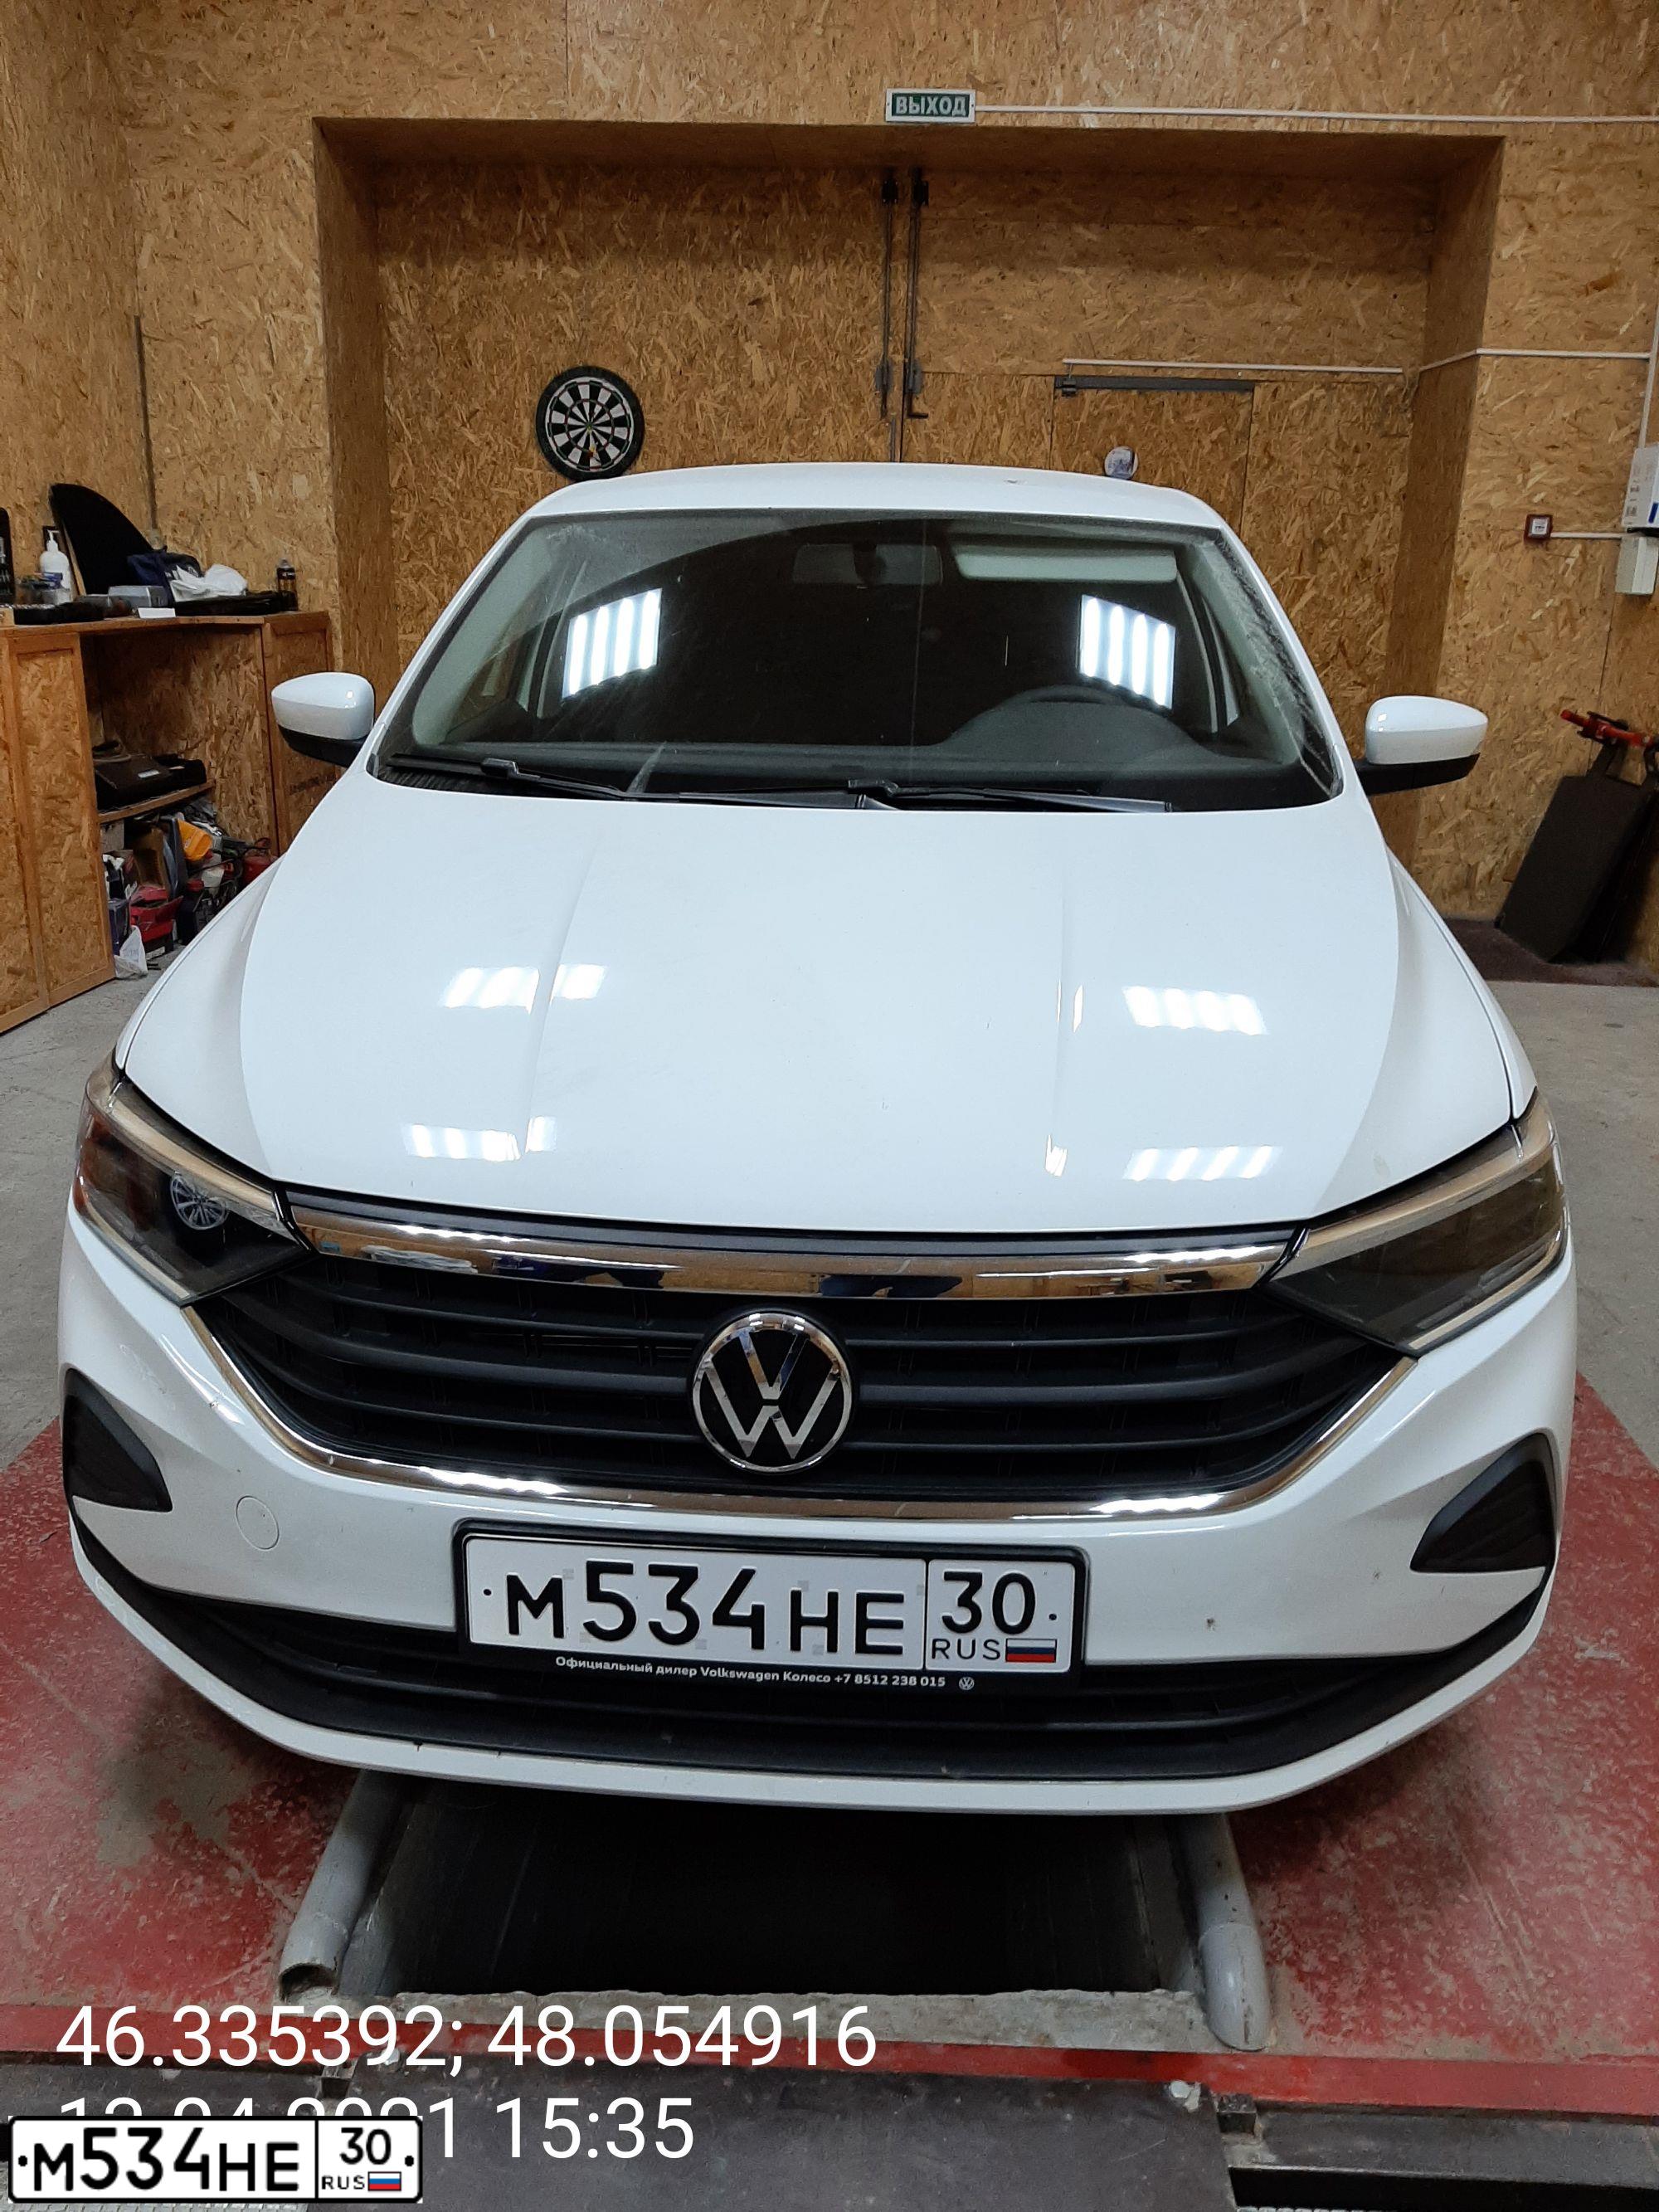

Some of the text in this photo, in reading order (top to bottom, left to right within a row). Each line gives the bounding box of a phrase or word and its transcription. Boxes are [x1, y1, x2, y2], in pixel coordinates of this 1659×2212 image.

[896, 95, 966, 116] ВЫХОД
[941, 1571, 1036, 1635] 30
[932, 1638, 1001, 1660] RUS
[555, 1656, 946, 1687] Официальный дилер Volkswagen Колесо +7 8512 238 015
